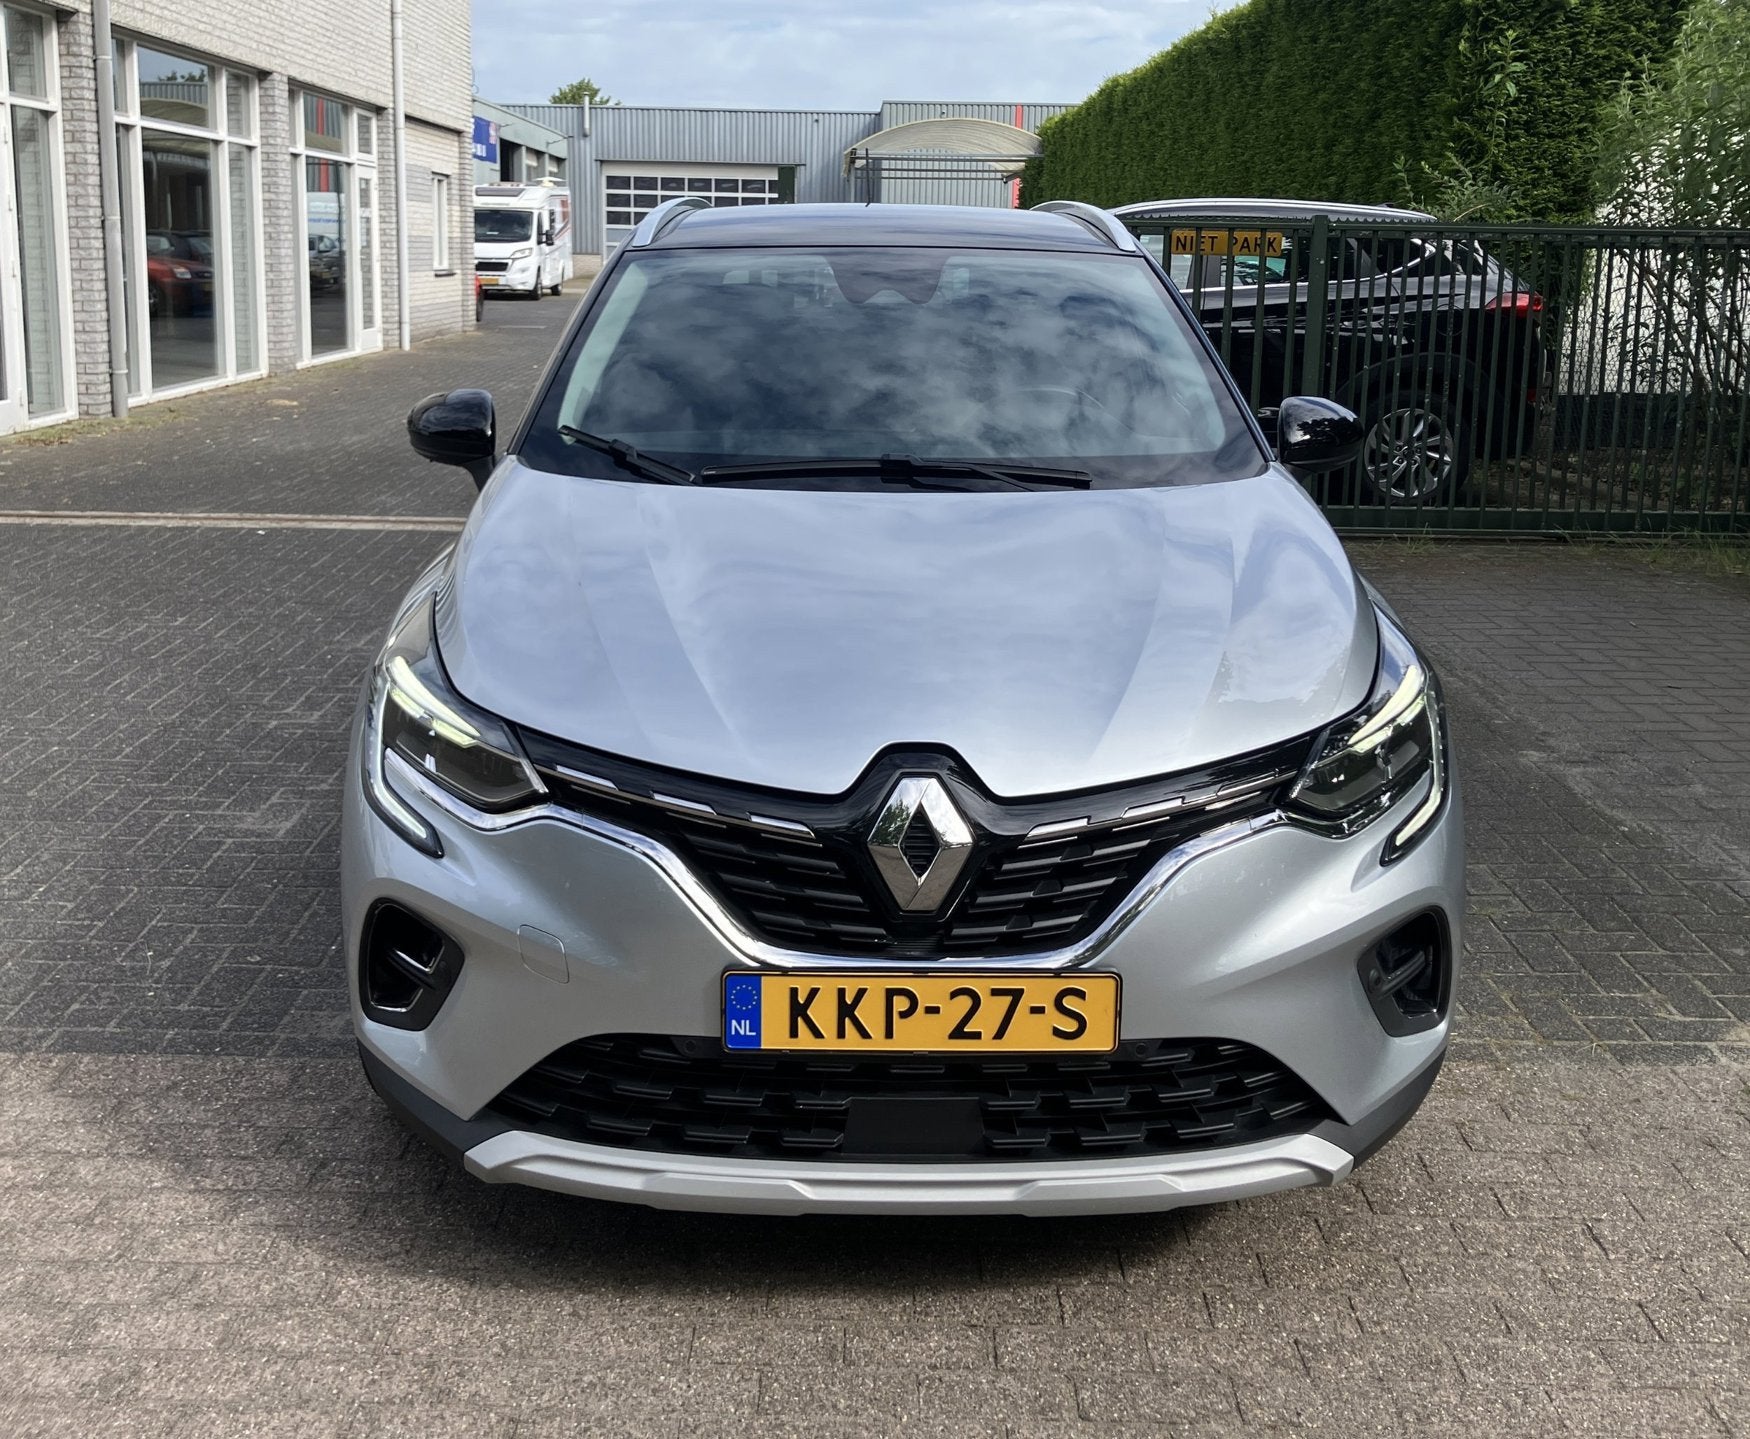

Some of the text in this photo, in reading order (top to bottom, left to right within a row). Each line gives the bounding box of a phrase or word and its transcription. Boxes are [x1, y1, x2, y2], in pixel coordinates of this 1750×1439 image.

[1175, 235, 1218, 252] NIET
[788, 986, 1088, 1040] KKP-27-S
[731, 1019, 756, 1036] NL
